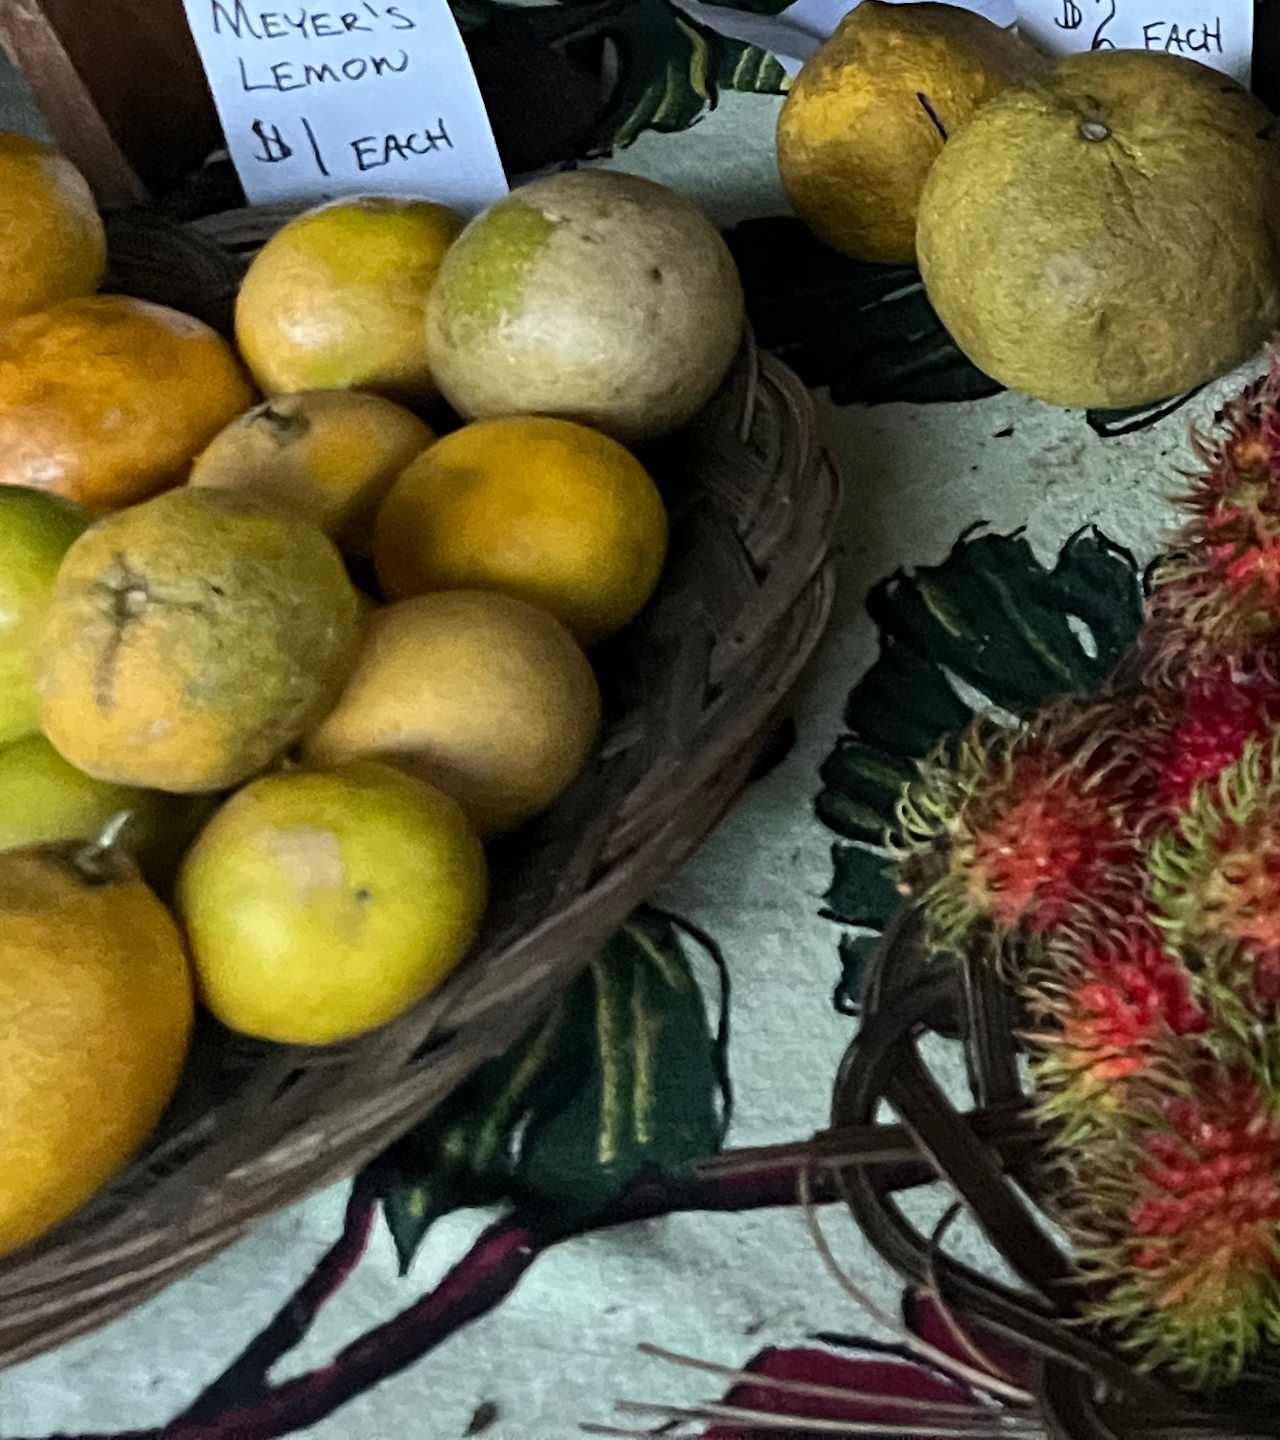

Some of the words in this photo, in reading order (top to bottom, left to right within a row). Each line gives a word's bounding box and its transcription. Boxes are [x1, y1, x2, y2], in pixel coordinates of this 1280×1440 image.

[239, 48, 410, 92] LEMON
[251, 117, 330, 177] $1
[350, 117, 455, 172] EACH
